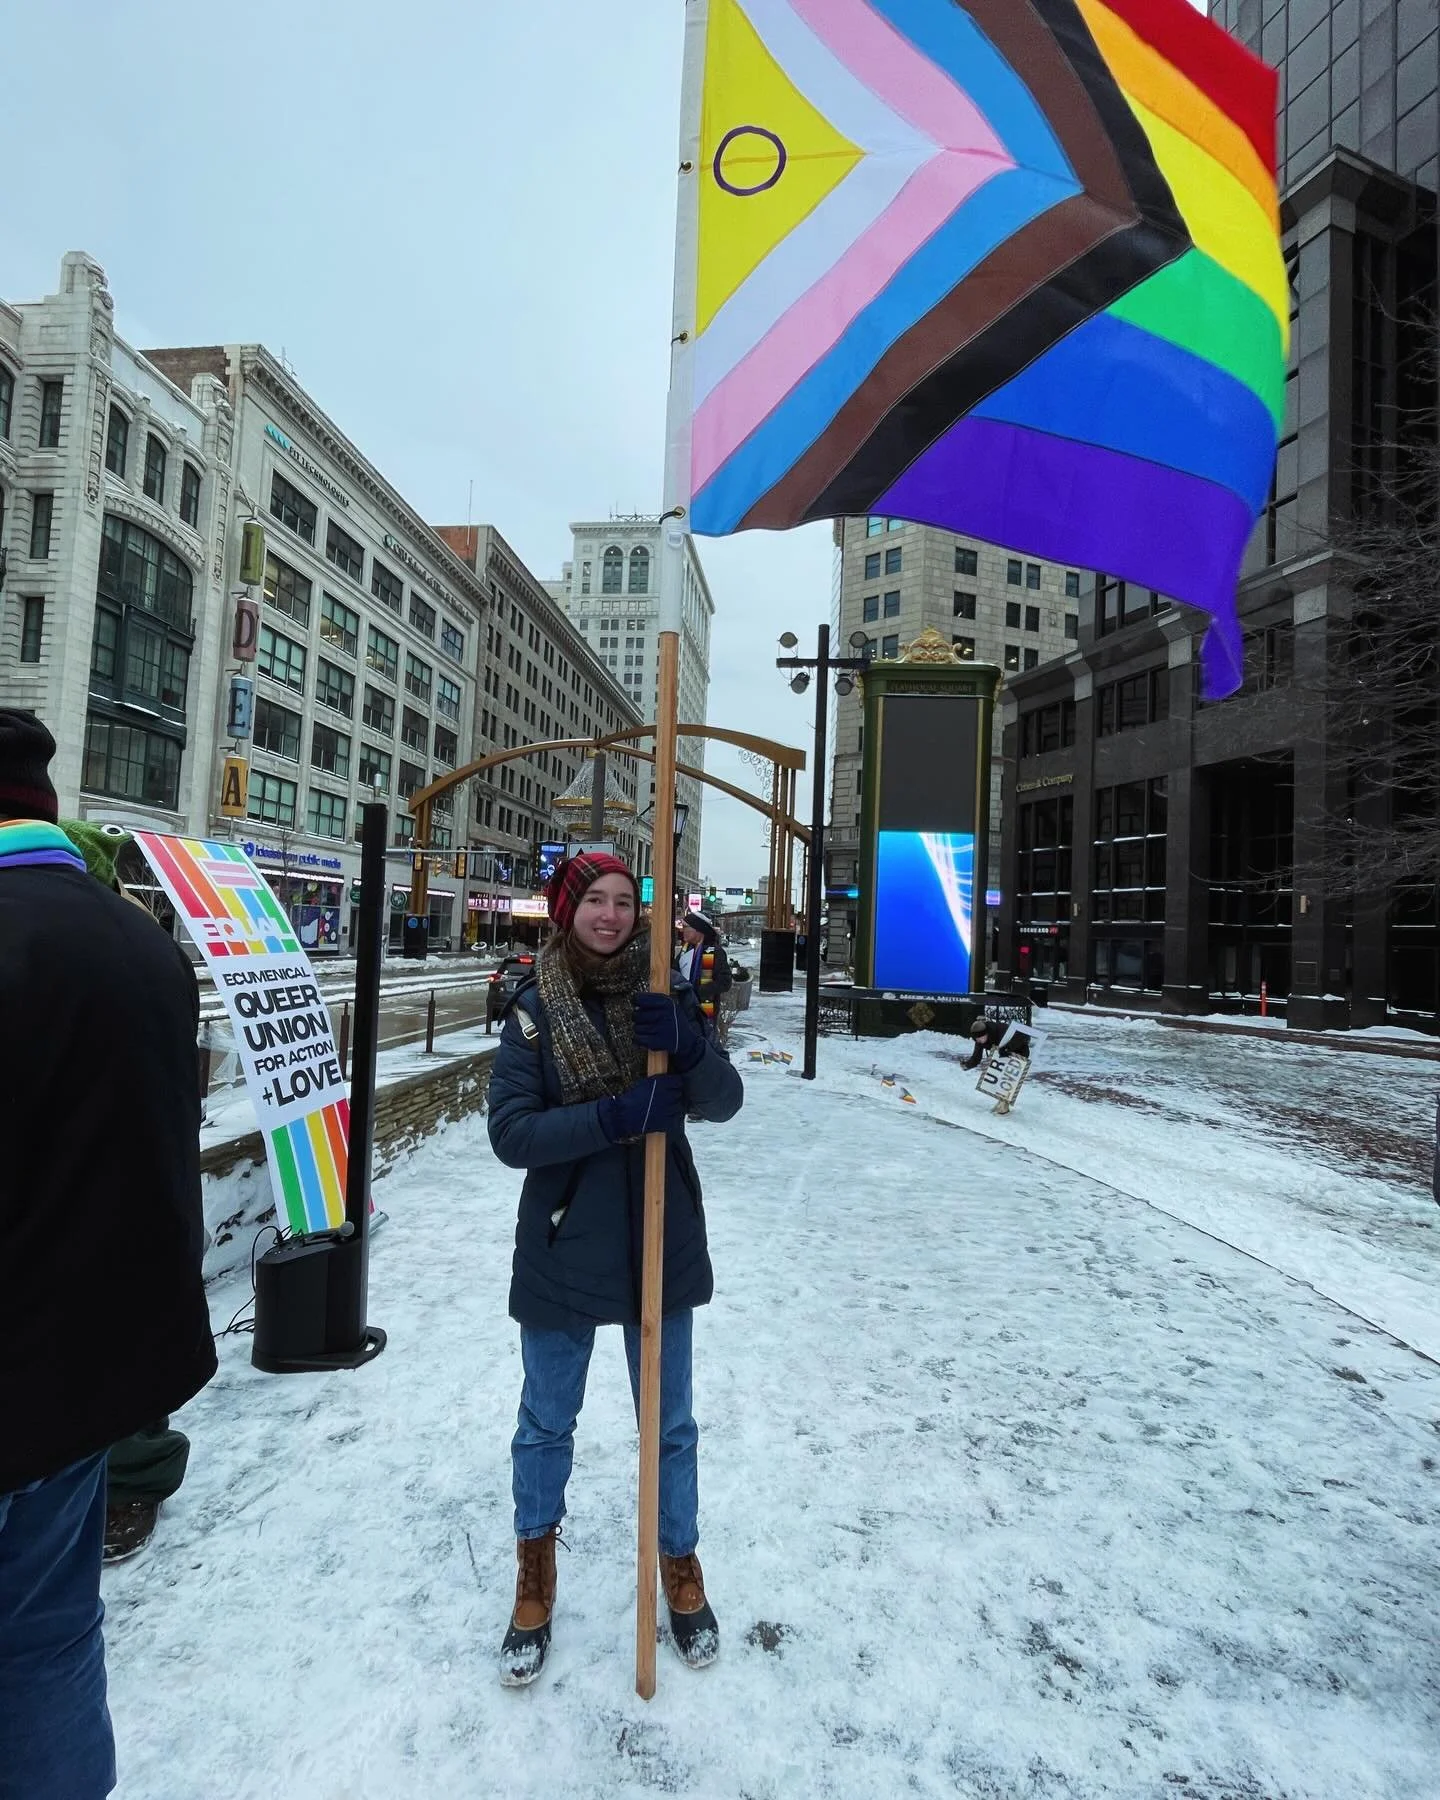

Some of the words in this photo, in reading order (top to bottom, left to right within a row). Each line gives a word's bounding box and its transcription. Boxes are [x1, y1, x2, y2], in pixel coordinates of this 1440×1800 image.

[198, 917, 291, 941] EQUAL
[222, 966, 311, 987] ECUMENICAL
[234, 983, 322, 1018] QUEER
[243, 1010, 330, 1052] UNION
[254, 1054, 287, 1076] FOR
[288, 1039, 335, 1066] ACTION
[995, 1059, 1022, 1098] LOVED
